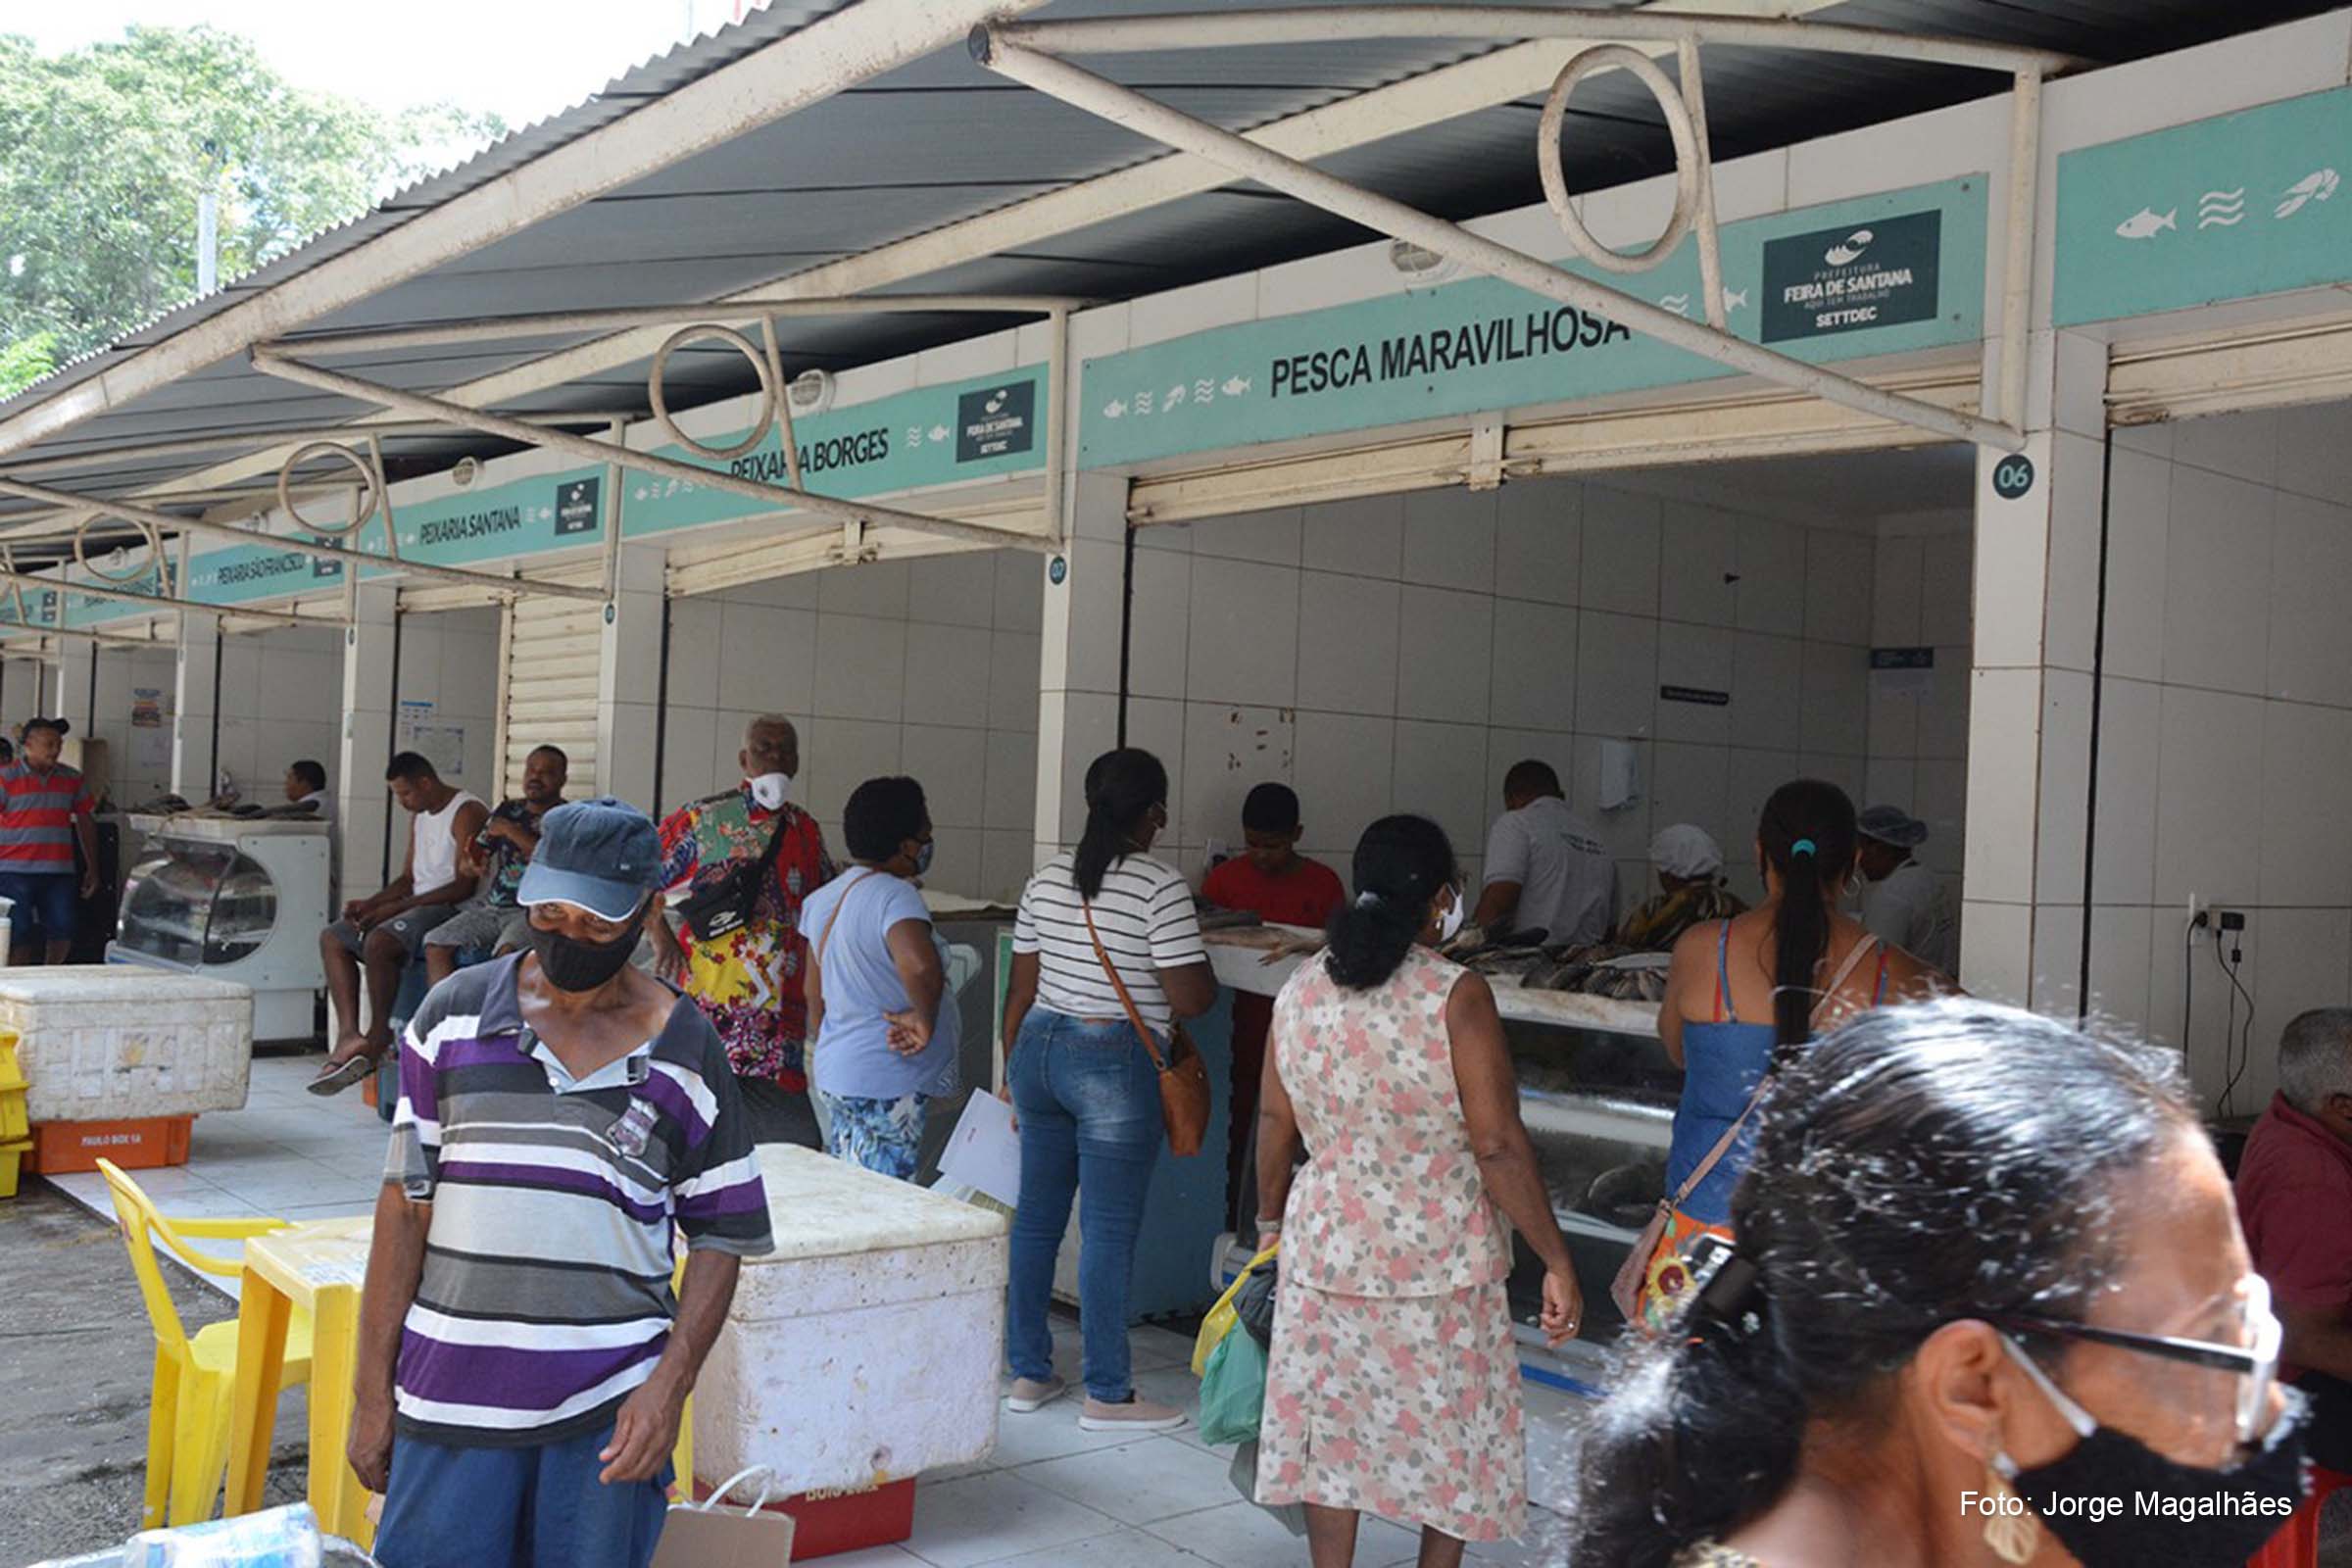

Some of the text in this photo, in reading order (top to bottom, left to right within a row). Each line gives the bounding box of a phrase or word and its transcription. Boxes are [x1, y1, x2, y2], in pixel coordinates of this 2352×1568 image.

[1784, 269, 1913, 304] FEIRA DE SANTANA
[1815, 263, 1881, 280] PREFEITURA
[1816, 306, 1878, 327] SETTDEC
[1271, 344, 1372, 398] PESCA
[813, 427, 889, 472] BORGES
[1999, 465, 2029, 488] 06
[420, 506, 521, 545] PEIXARIA SANTANA
